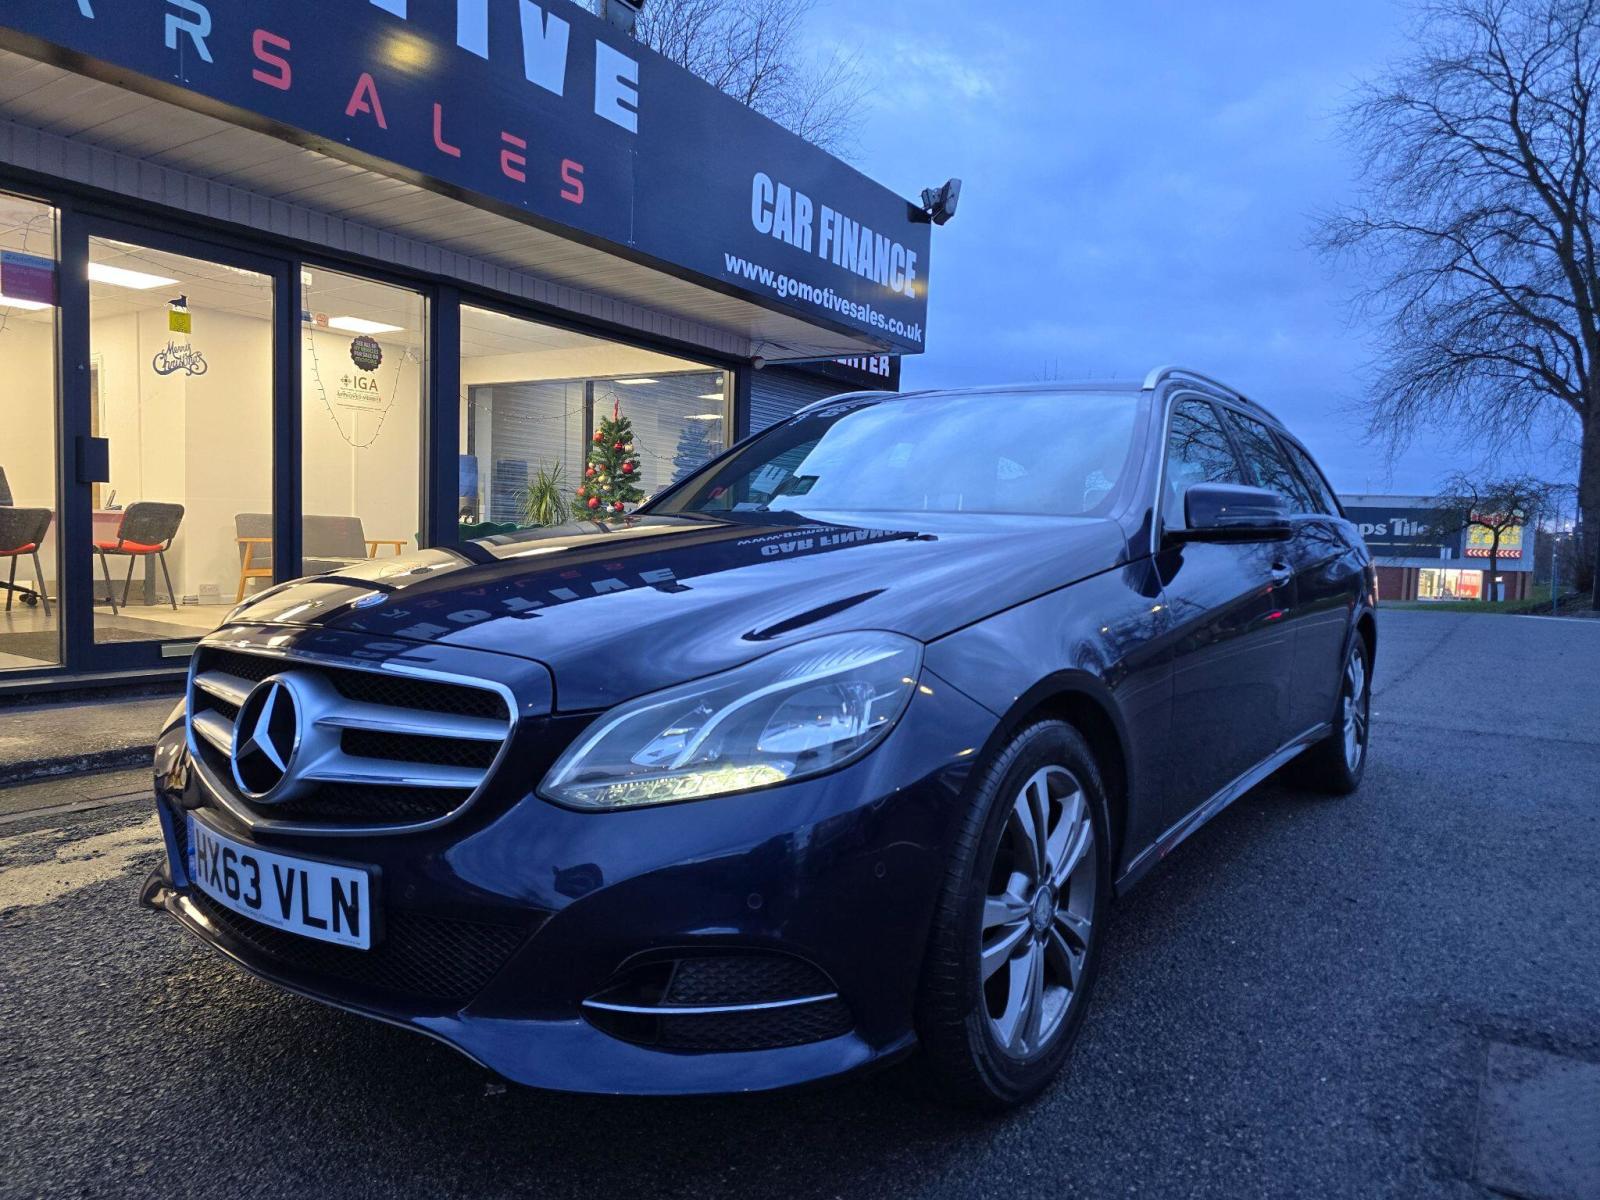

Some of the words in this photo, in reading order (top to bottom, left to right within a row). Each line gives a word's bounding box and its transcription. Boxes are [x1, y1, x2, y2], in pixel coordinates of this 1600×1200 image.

[369, 0, 639, 134] IVE
[752, 172, 814, 252] CAR
[819, 204, 918, 299] FINANCE
[725, 252, 922, 343] www.gomotivesales.co.uk
[353, 375, 379, 392] IGA
[195, 829, 262, 910] HX63
[272, 863, 360, 938] VLN
